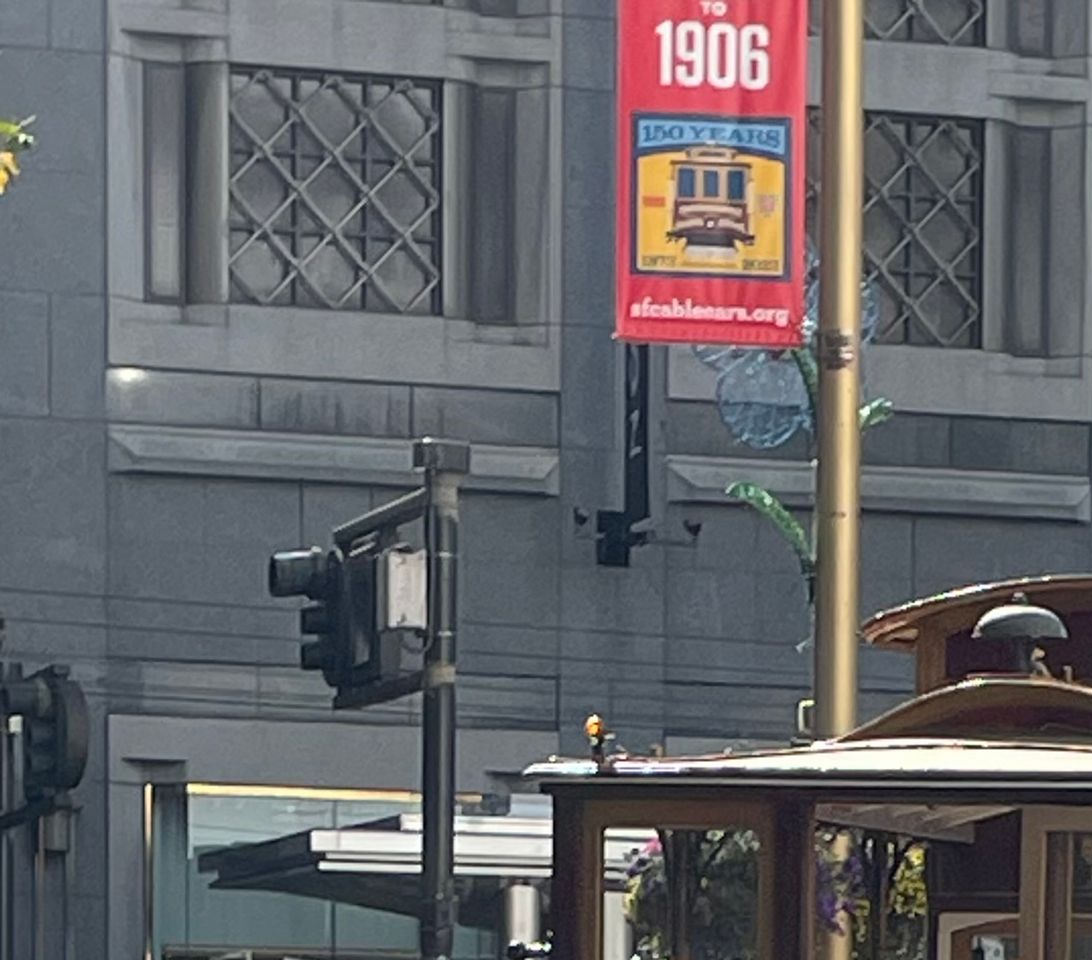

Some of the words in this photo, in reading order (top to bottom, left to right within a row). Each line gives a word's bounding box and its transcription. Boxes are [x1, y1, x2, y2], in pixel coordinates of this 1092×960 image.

[700, 0, 728, 16] TO
[655, 19, 770, 90] 1906
[642, 124, 684, 143] 150
[689, 125, 781, 148] YEARS
[630, 296, 789, 327] sfcablecars.org
